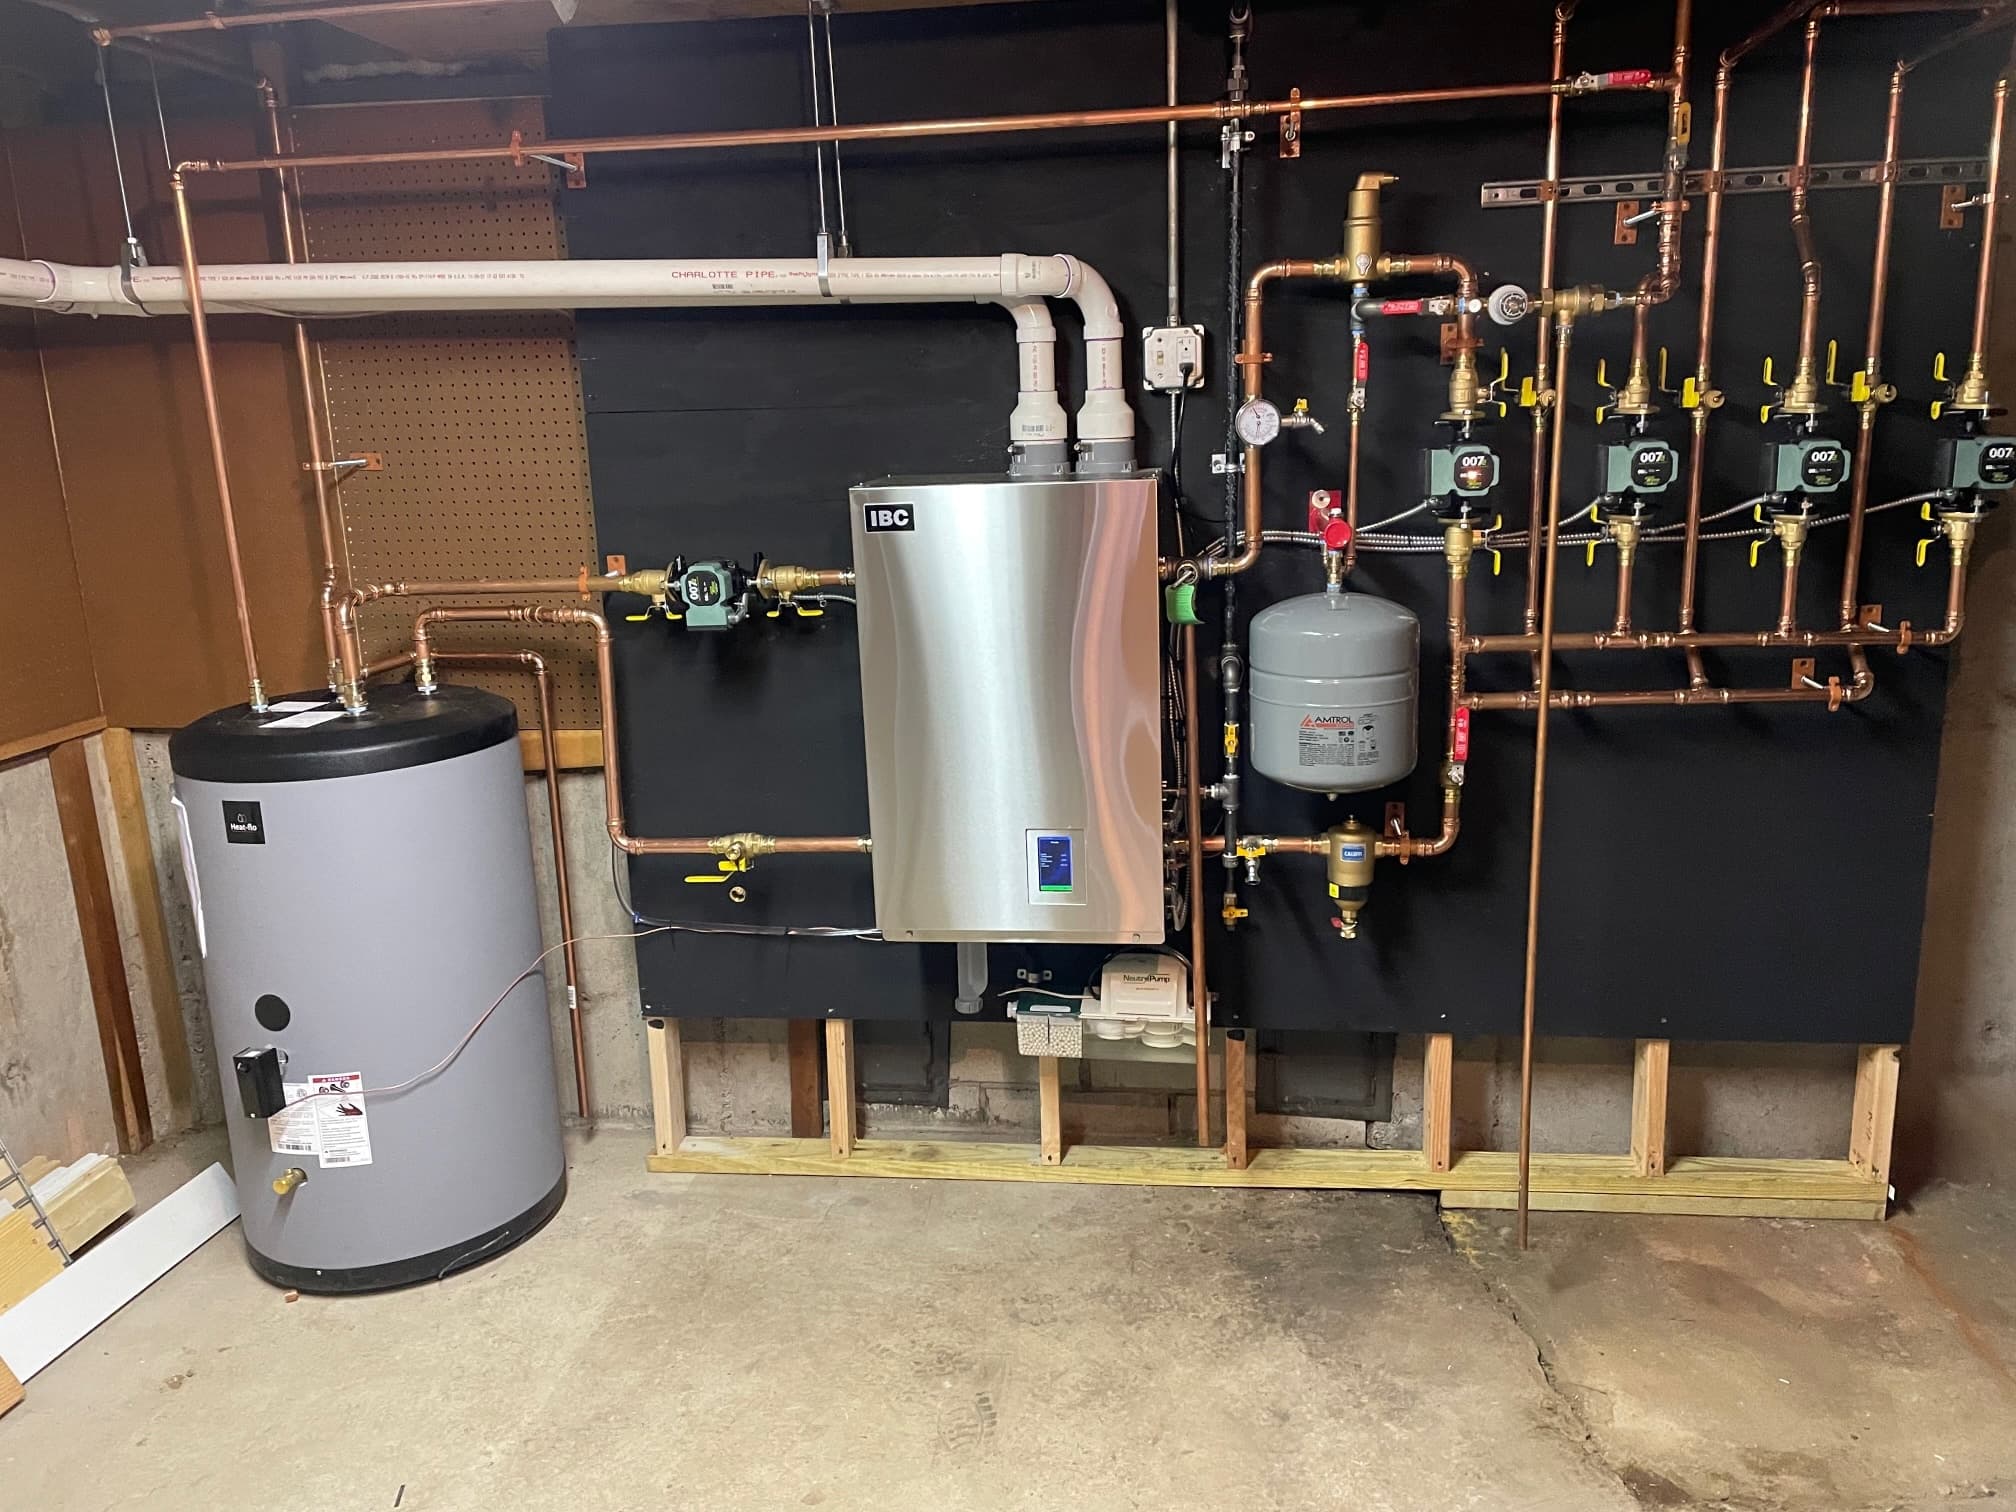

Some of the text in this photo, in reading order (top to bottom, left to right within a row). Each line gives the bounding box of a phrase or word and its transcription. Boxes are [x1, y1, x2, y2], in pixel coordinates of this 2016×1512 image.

[671, 271, 737, 279] CHARLOTTE
[870, 509, 909, 526] IBC
[1315, 715, 1352, 724] AMTROL
[230, 823, 258, 832] Heat-flo
